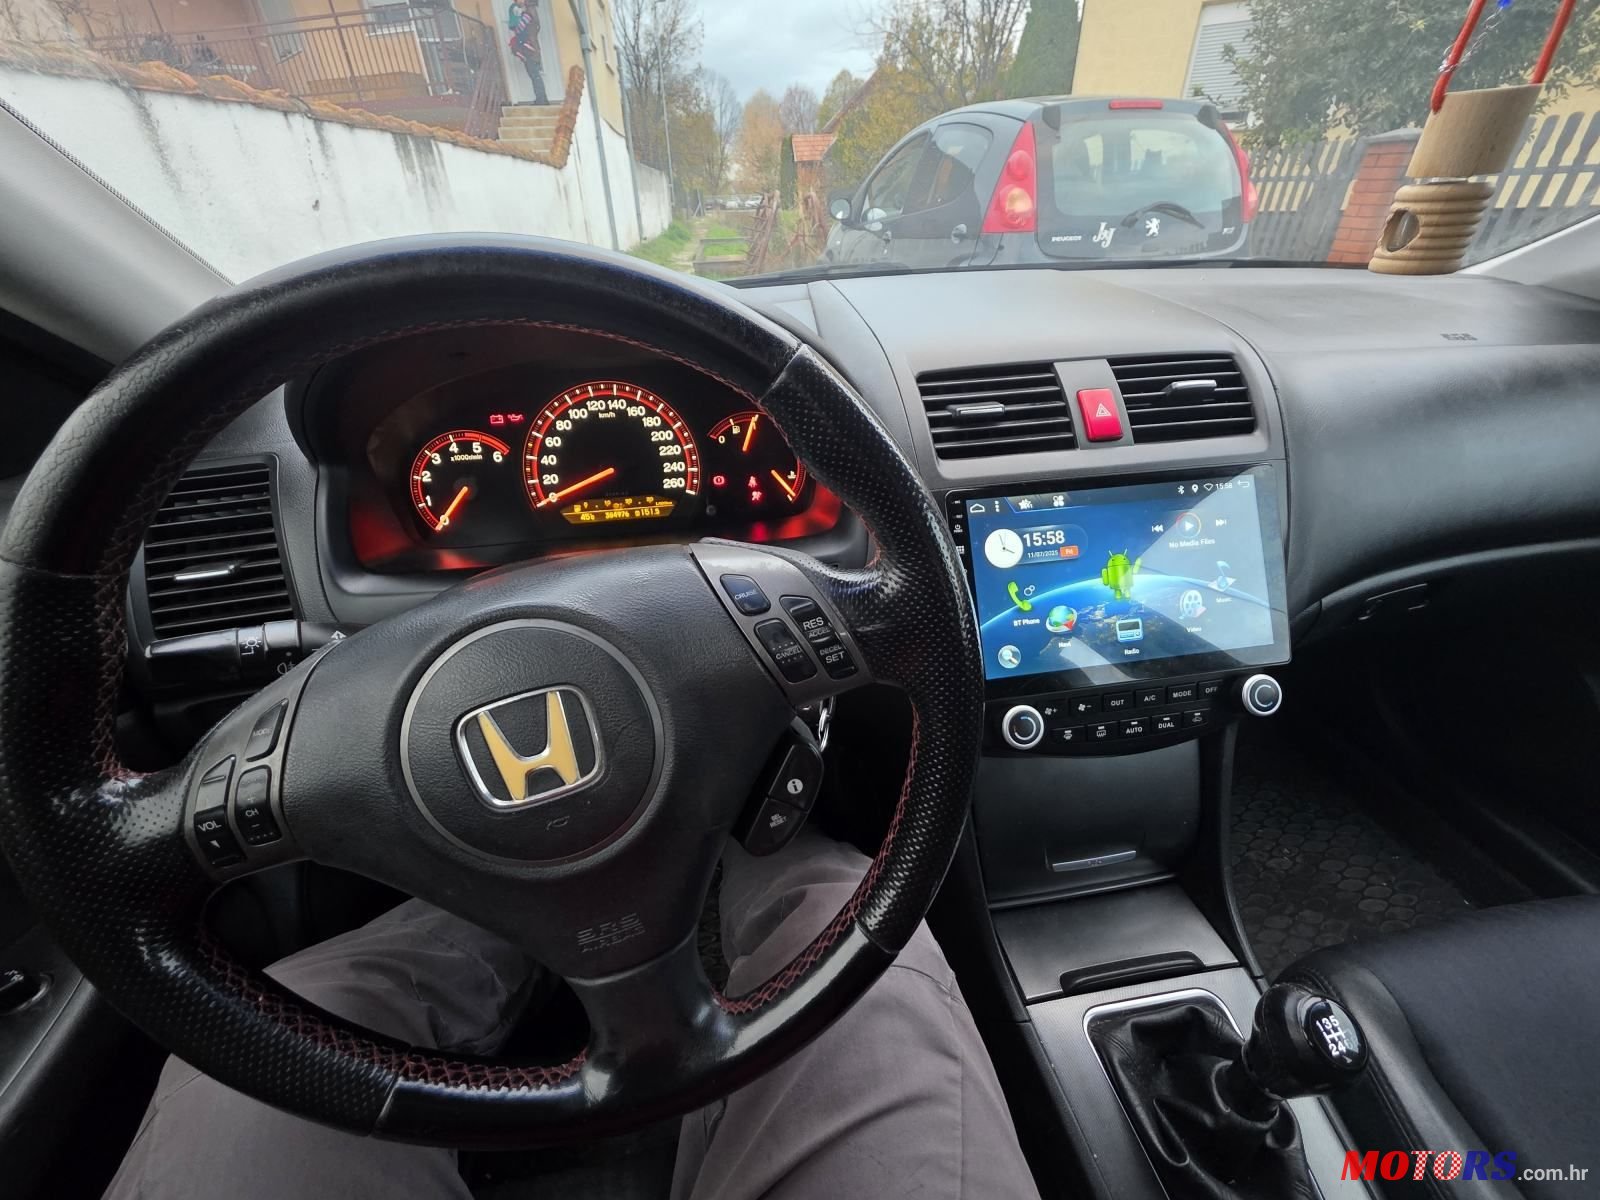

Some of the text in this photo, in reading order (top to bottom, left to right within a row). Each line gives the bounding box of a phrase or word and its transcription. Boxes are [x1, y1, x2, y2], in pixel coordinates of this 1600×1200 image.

[586, 400, 606, 411] 120
[608, 399, 627, 410] 140
[568, 408, 588, 420] 100
[626, 406, 646, 417] 160
[555, 420, 572, 431] 80
[642, 416, 661, 427] 180
[651, 430, 673, 441] 200
[545, 436, 562, 447] 60
[449, 443, 459, 453] 4
[472, 442, 482, 453] 5
[659, 445, 681, 456] 220
[431, 453, 442, 465] 3
[492, 451, 503, 463] 6
[540, 455, 557, 466] 40
[663, 462, 685, 473] 240
[421, 471, 432, 482] 2
[542, 474, 559, 485] 20
[663, 477, 685, 489] 260
[425, 495, 432, 506] 1
[1022, 530, 1065, 547] 15:58
[802, 616, 825, 630] RES
[825, 650, 846, 664] SET
[1143, 694, 1157, 702] A/C
[1172, 690, 1192, 698] MODE
[1125, 726, 1143, 734] AUTO
[1158, 721, 1175, 729] DUAL
[245, 809, 259, 817] CH
[198, 820, 222, 832] VOL
